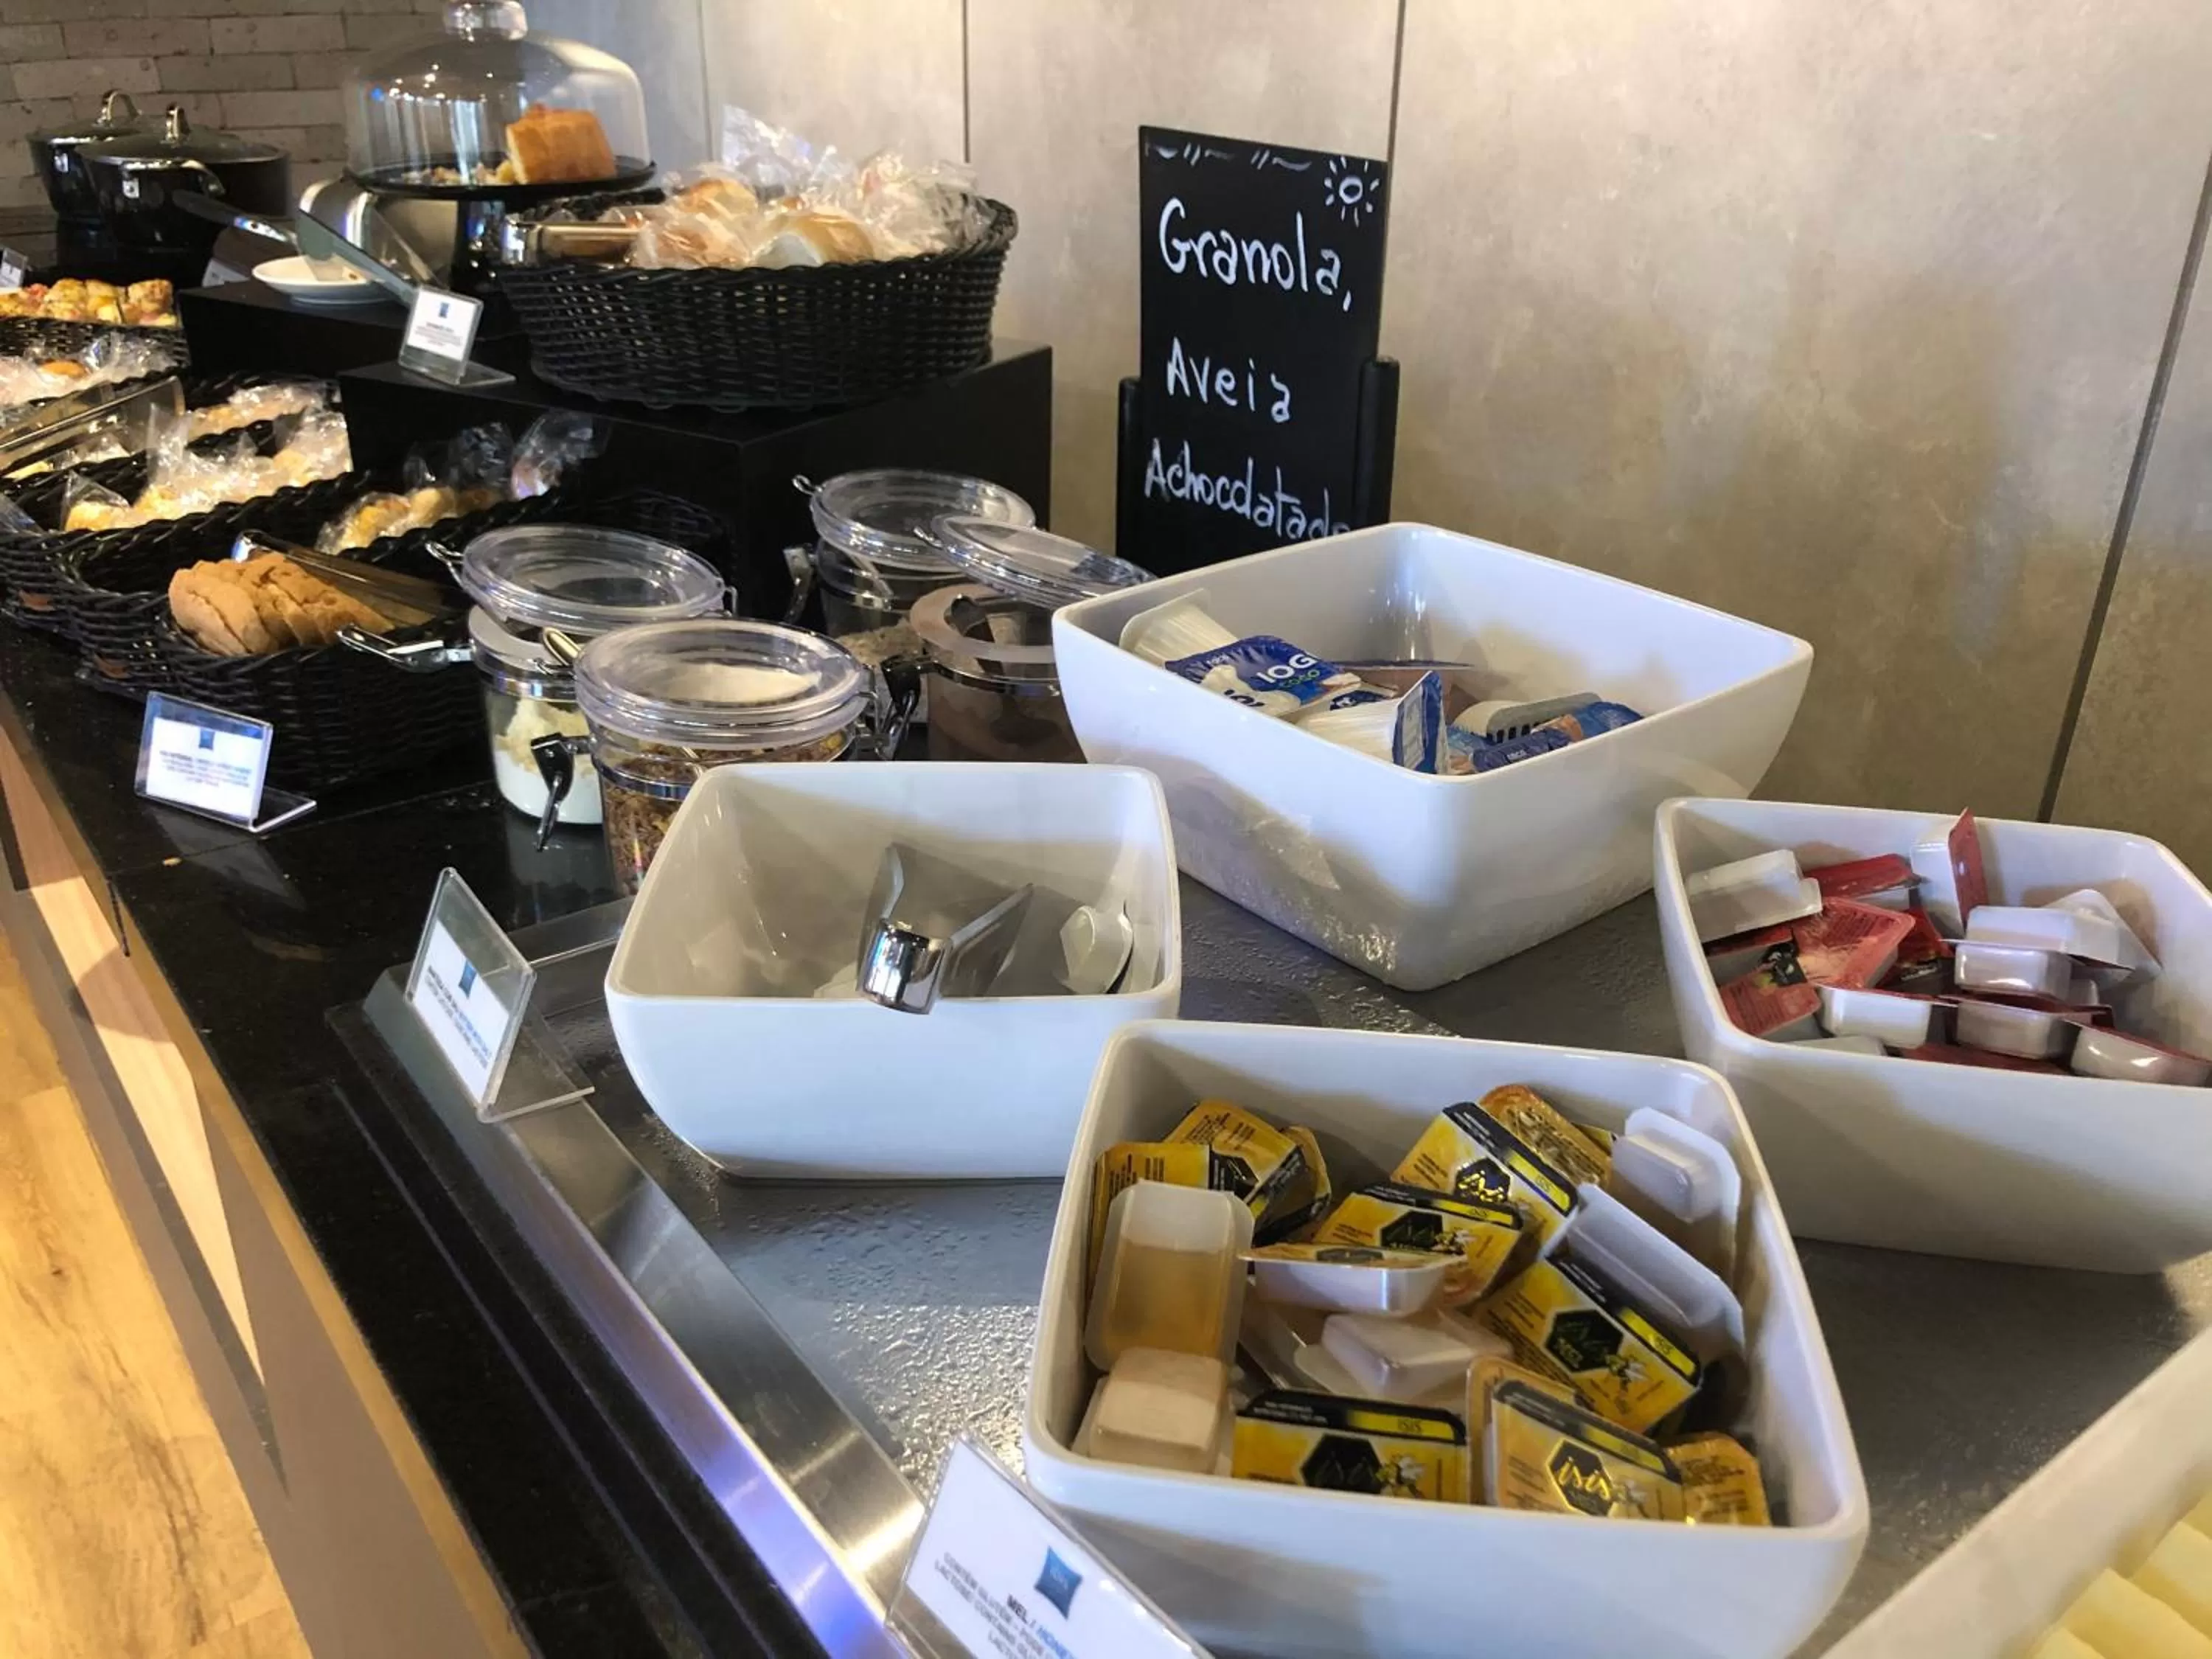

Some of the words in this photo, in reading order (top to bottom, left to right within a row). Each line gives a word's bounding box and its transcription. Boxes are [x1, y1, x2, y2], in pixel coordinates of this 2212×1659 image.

[1158, 197, 1352, 312] Granola,
[1166, 336, 1291, 423] Aveia
[1256, 653, 1318, 684] IOG
